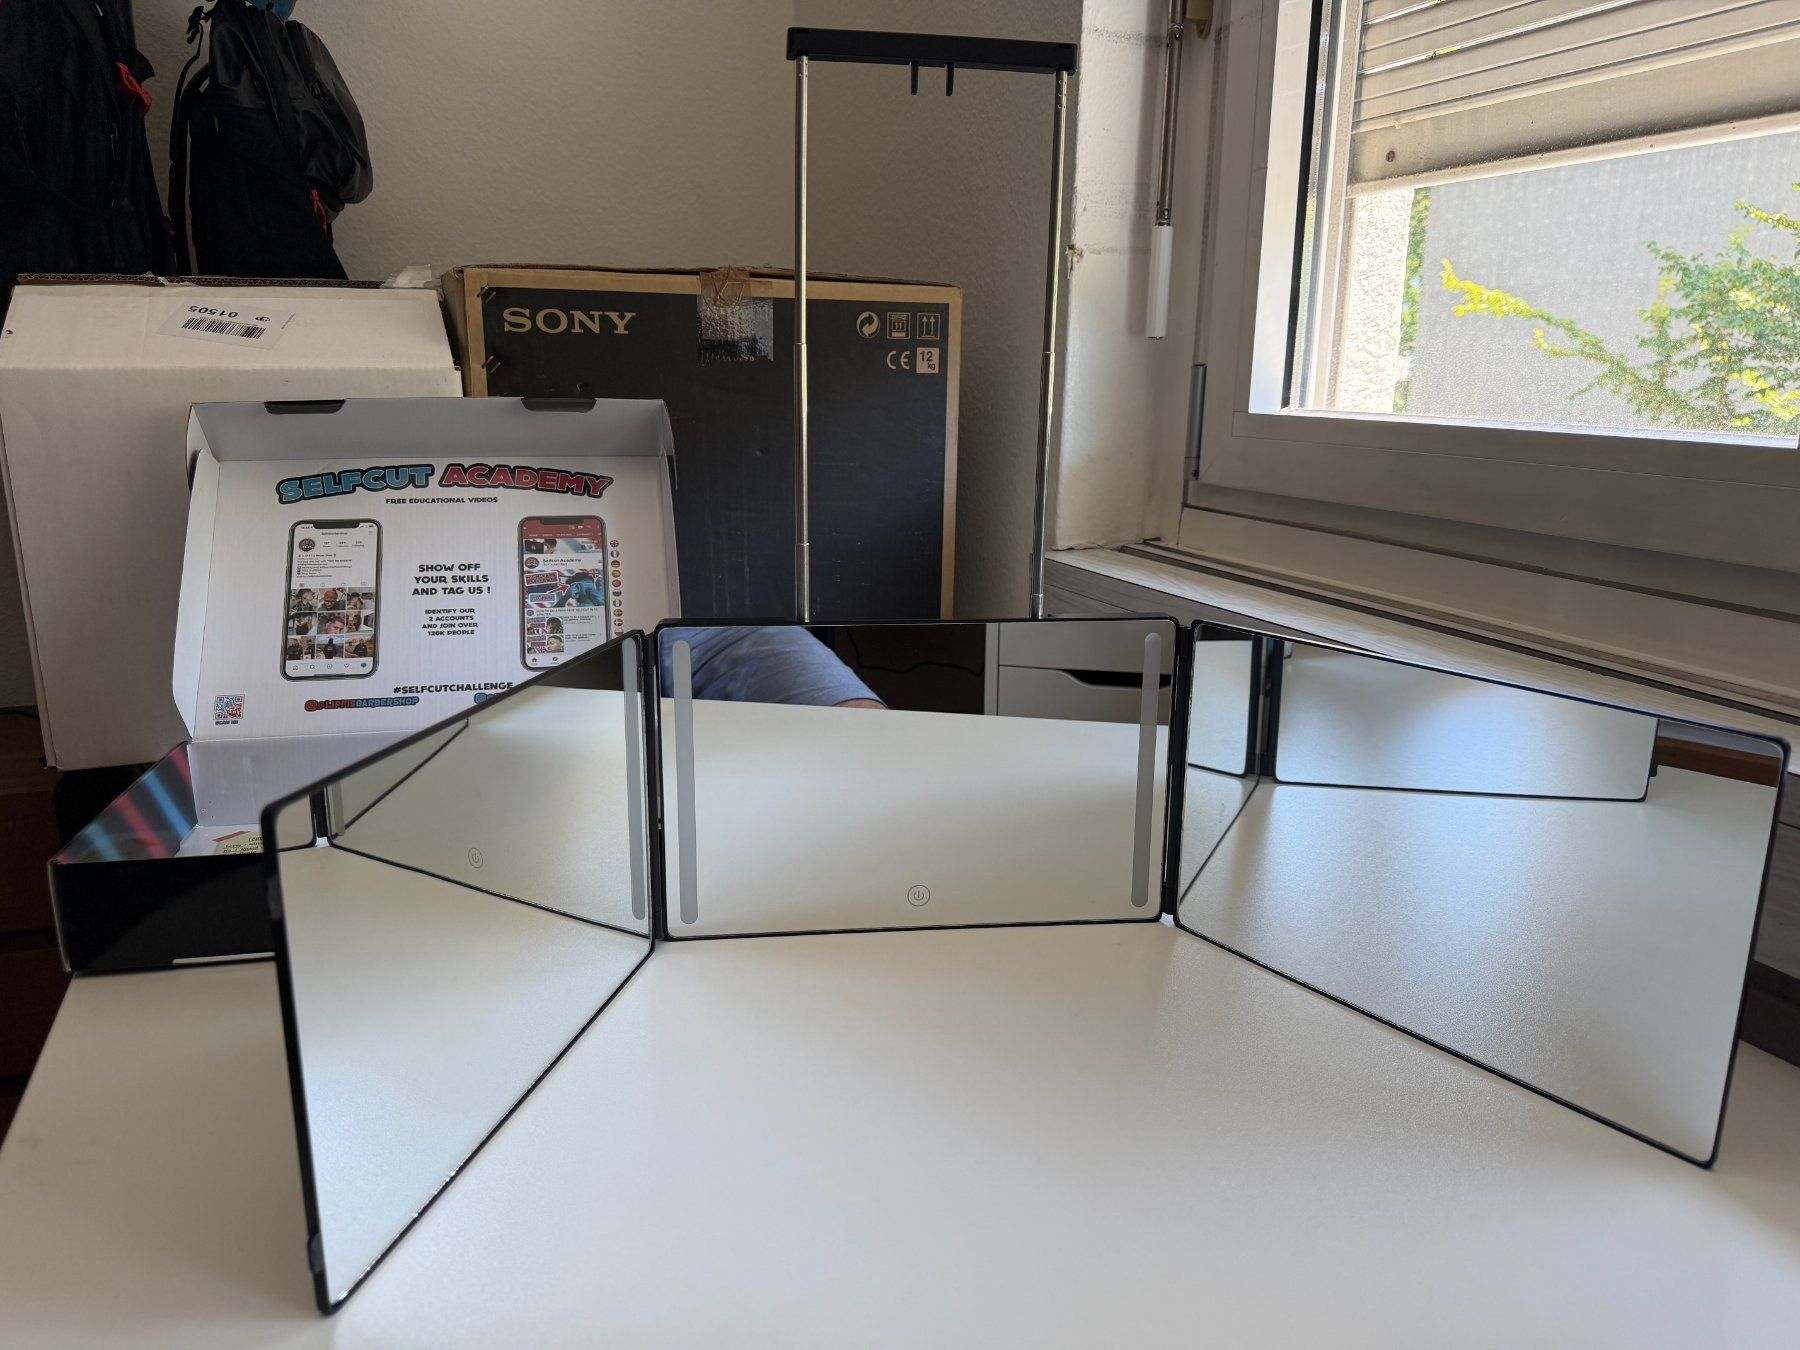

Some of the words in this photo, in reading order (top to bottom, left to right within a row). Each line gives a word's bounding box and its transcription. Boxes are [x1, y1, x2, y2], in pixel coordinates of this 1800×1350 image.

[187, 305, 239, 318] 01505
[502, 307, 637, 335] SONY
[919, 350, 934, 362] 12
[927, 361, 936, 371] kg
[276, 463, 435, 504] SELFCUT
[438, 462, 614, 499] ACADEMY
[418, 564, 455, 572] SHOW
[458, 563, 481, 571] OFF
[414, 575, 448, 584] YOUR
[451, 574, 489, 583] SKILLS
[412, 587, 438, 596] AND
[441, 586, 465, 595] TAG
[468, 586, 484, 594] US
[435, 614, 474, 622] ACCOUNTS
[393, 681, 515, 694] #SELFCUTCHALLENGE
